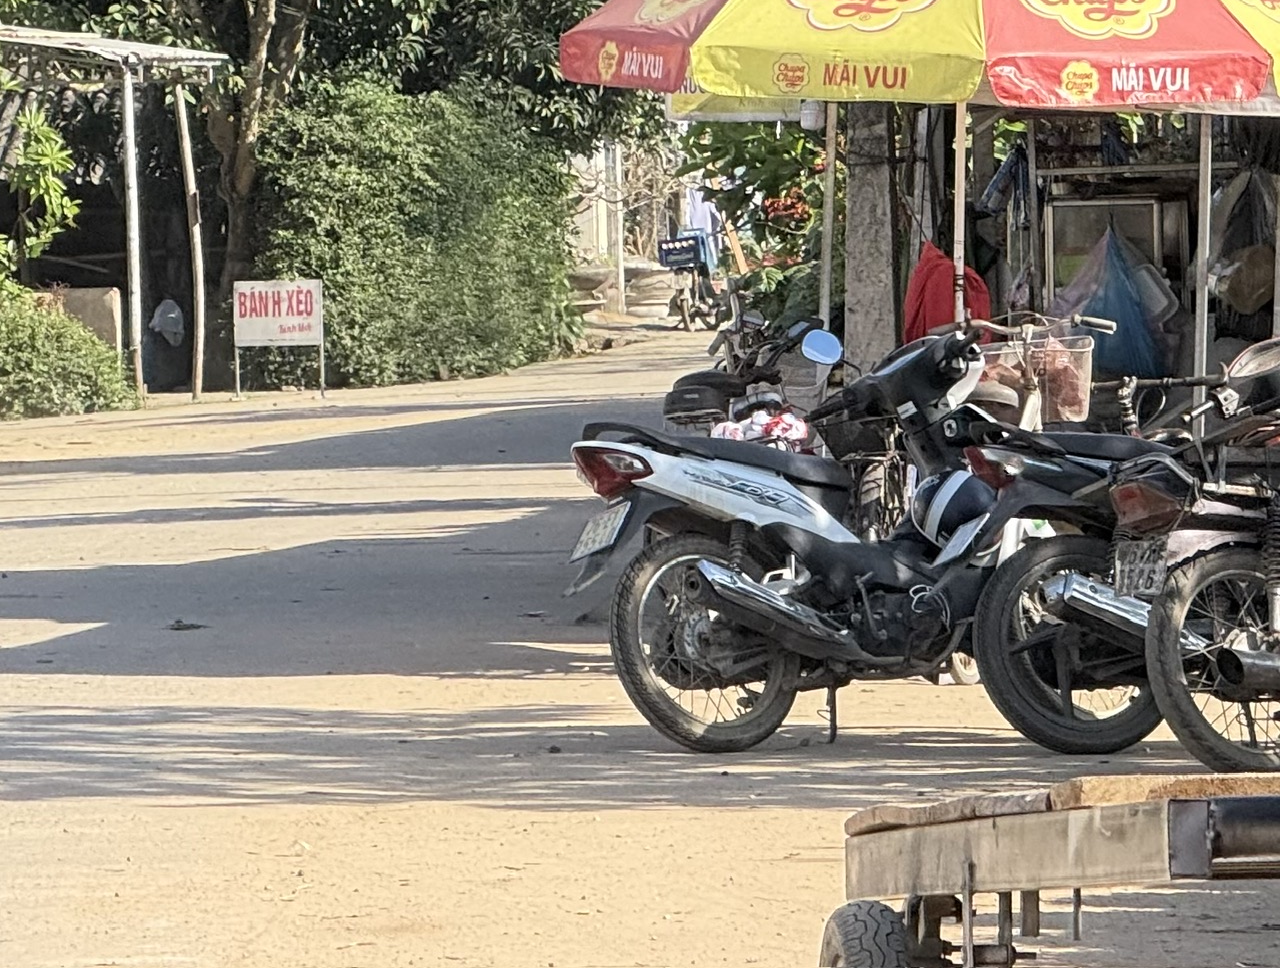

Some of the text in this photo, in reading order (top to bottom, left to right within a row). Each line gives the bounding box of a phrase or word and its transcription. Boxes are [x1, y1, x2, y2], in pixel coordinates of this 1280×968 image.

[642, 53, 663, 79] VUI
[823, 60, 907, 89] MÃI VUI
[1111, 63, 1190, 92] MÃI VUI
[238, 285, 313, 318] BÁNH XÈO
